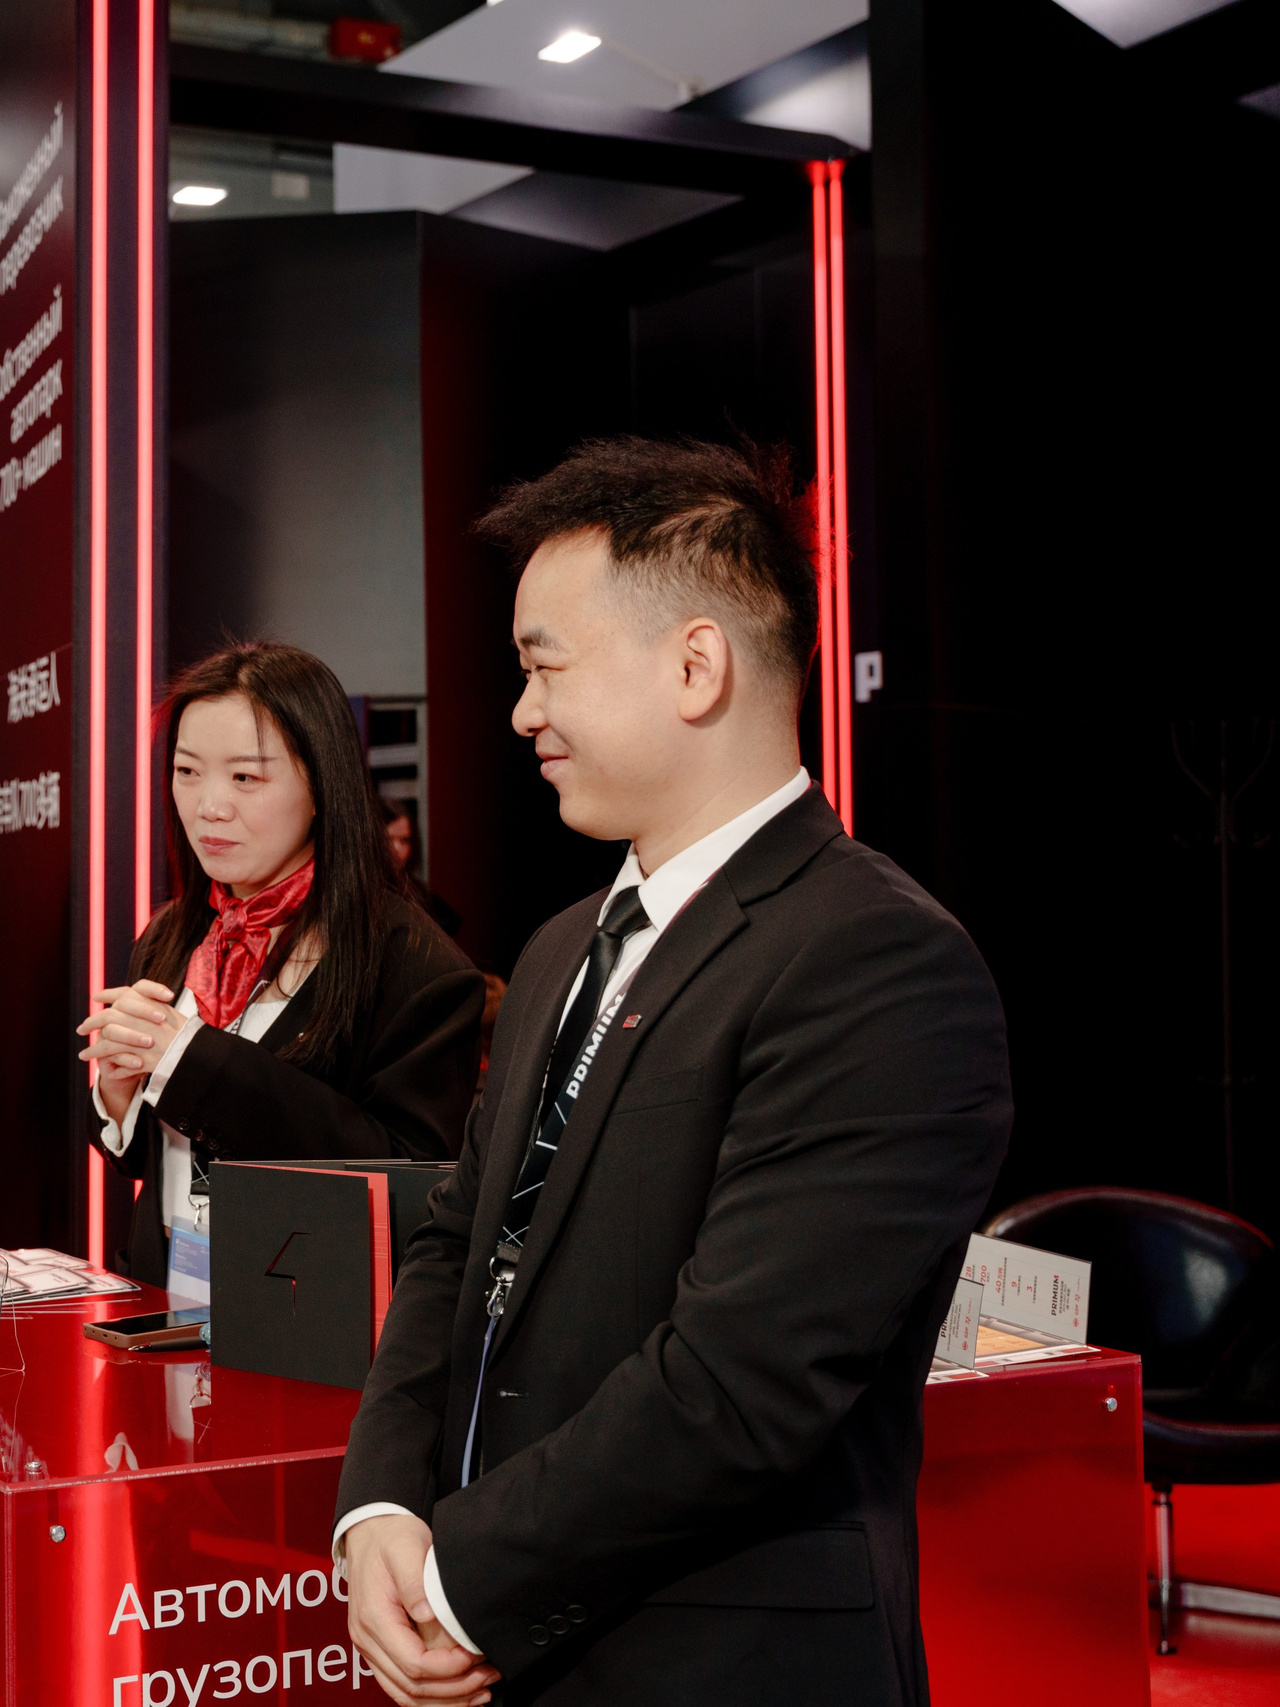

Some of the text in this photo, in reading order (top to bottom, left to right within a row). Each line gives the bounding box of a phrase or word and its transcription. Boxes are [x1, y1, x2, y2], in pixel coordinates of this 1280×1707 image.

[10, 358, 64, 444] автопарк
[854, 650, 884, 703] P
[1050, 1274, 1060, 1317] PRIMUM
